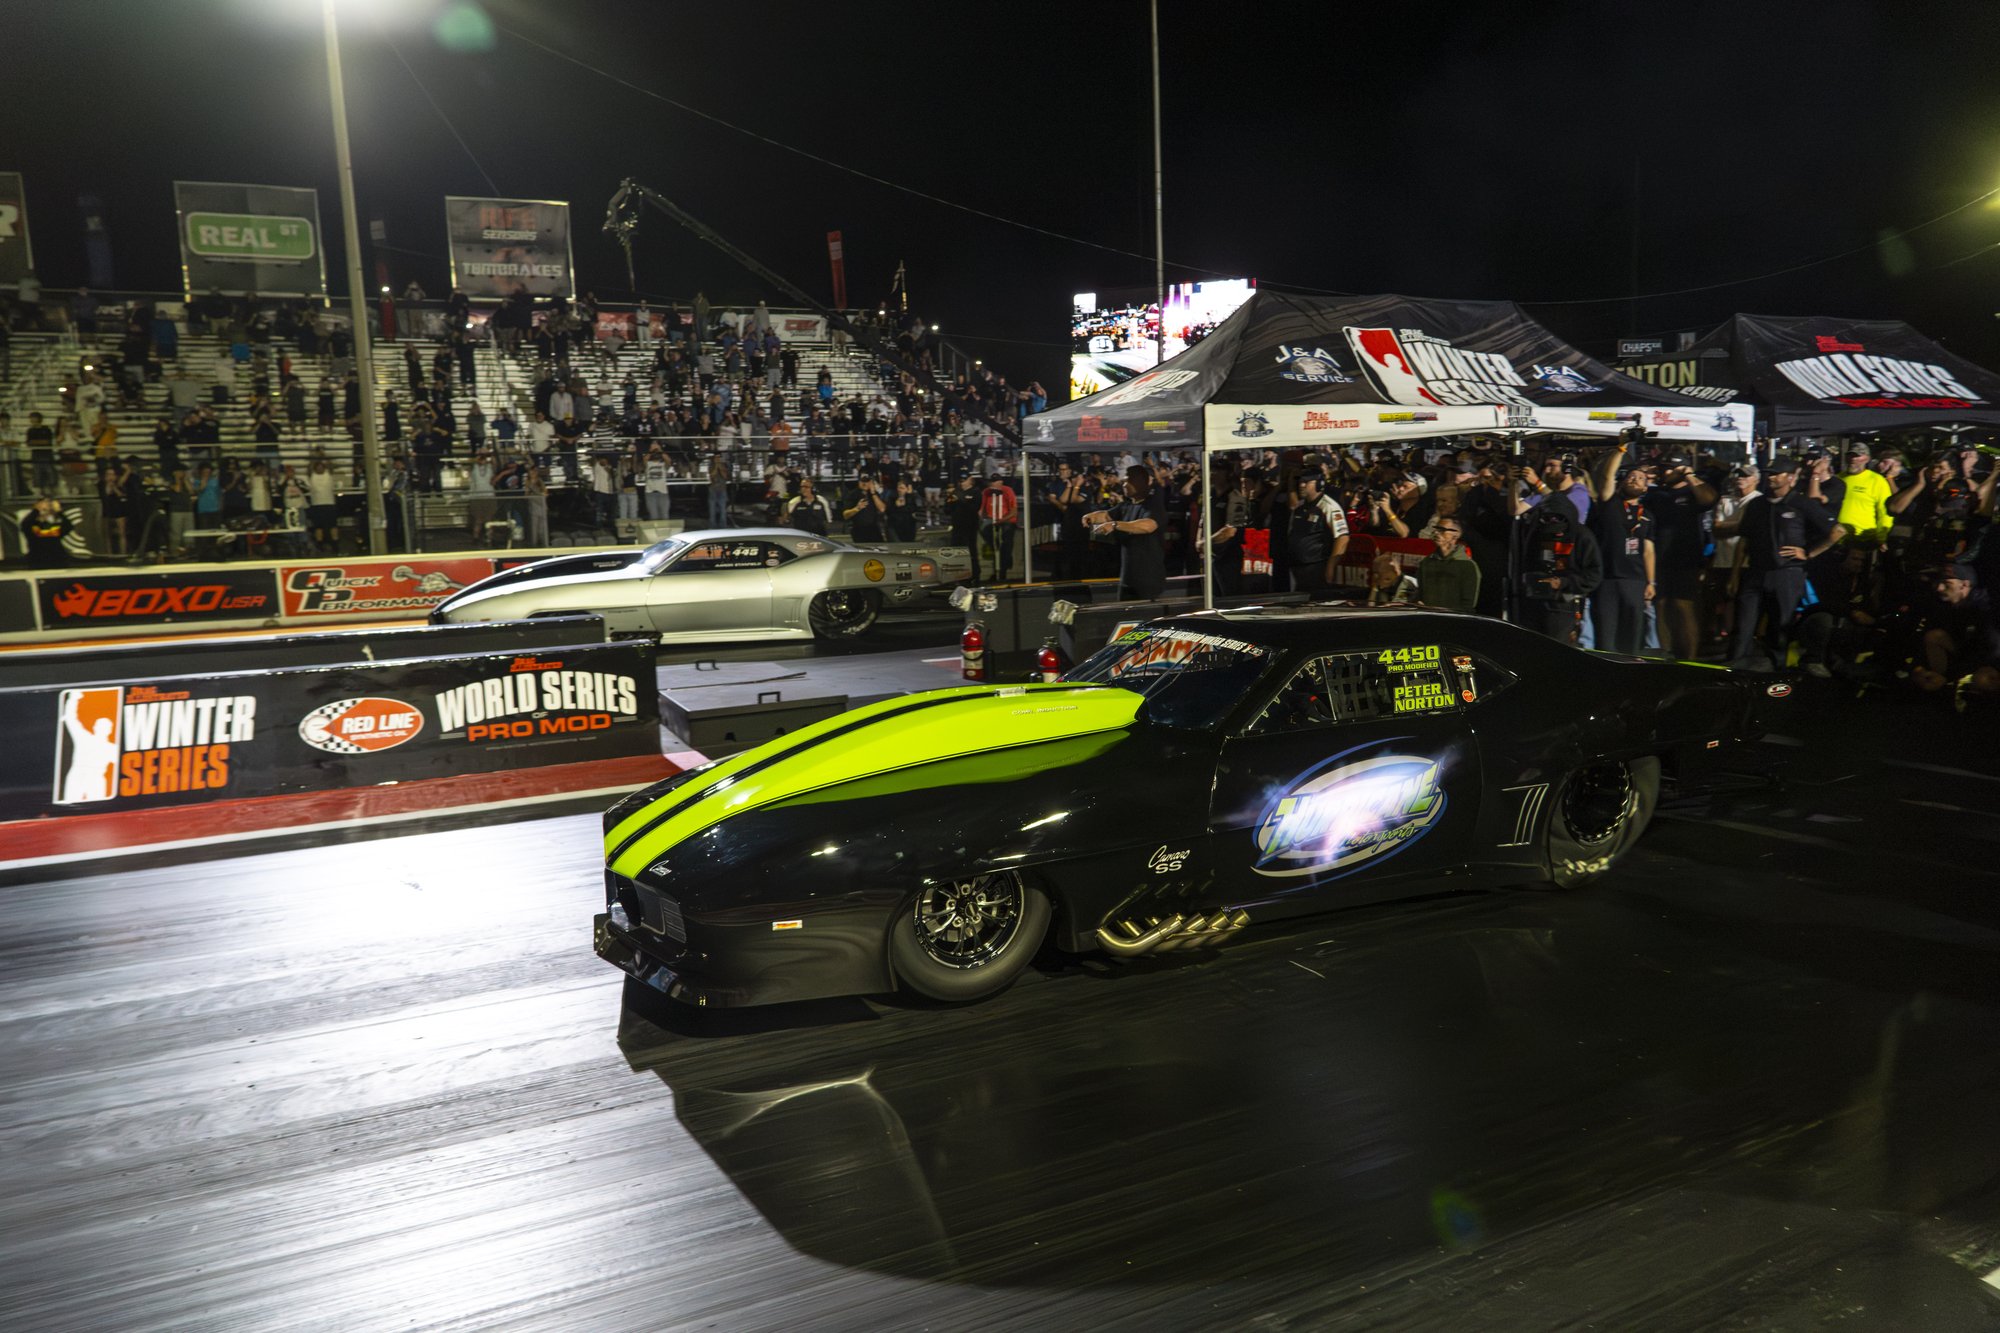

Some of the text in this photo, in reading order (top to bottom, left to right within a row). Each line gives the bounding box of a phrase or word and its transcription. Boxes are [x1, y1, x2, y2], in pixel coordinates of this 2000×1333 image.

[199, 224, 299, 248] REAL ST
[1274, 345, 1342, 368] J&A
[1622, 343, 1652, 352] CHAPS
[1403, 341, 1528, 386] WINTER
[1532, 364, 1588, 382] J&A
[1614, 360, 1697, 388] NTON
[1282, 373, 1355, 383] SERVICE
[1774, 353, 1982, 400] WORLD SERIES
[1427, 379, 1541, 407] SERIES
[1303, 419, 1360, 431] ILLUSTRATED
[1306, 411, 1330, 421] DRAG
[732, 547, 760, 557] 445
[286, 568, 383, 593] QUICK
[90, 585, 228, 617] BOXO
[297, 588, 445, 613] PERFORMANC
[1377, 645, 1440, 665] 4450
[1388, 661, 1439, 673] PRO MODIFIED
[435, 670, 638, 732] WORLD SERIES
[1394, 683, 1442, 699] PETER
[1394, 693, 1455, 713] NORTON
[123, 695, 257, 752] WINTER
[341, 711, 417, 734] RED LINE
[531, 711, 549, 719] OF
[467, 713, 613, 742] PRO MOD
[120, 743, 230, 797] SERIES
[1148, 845, 1191, 868] Camaro
[1155, 860, 1182, 874] SS
